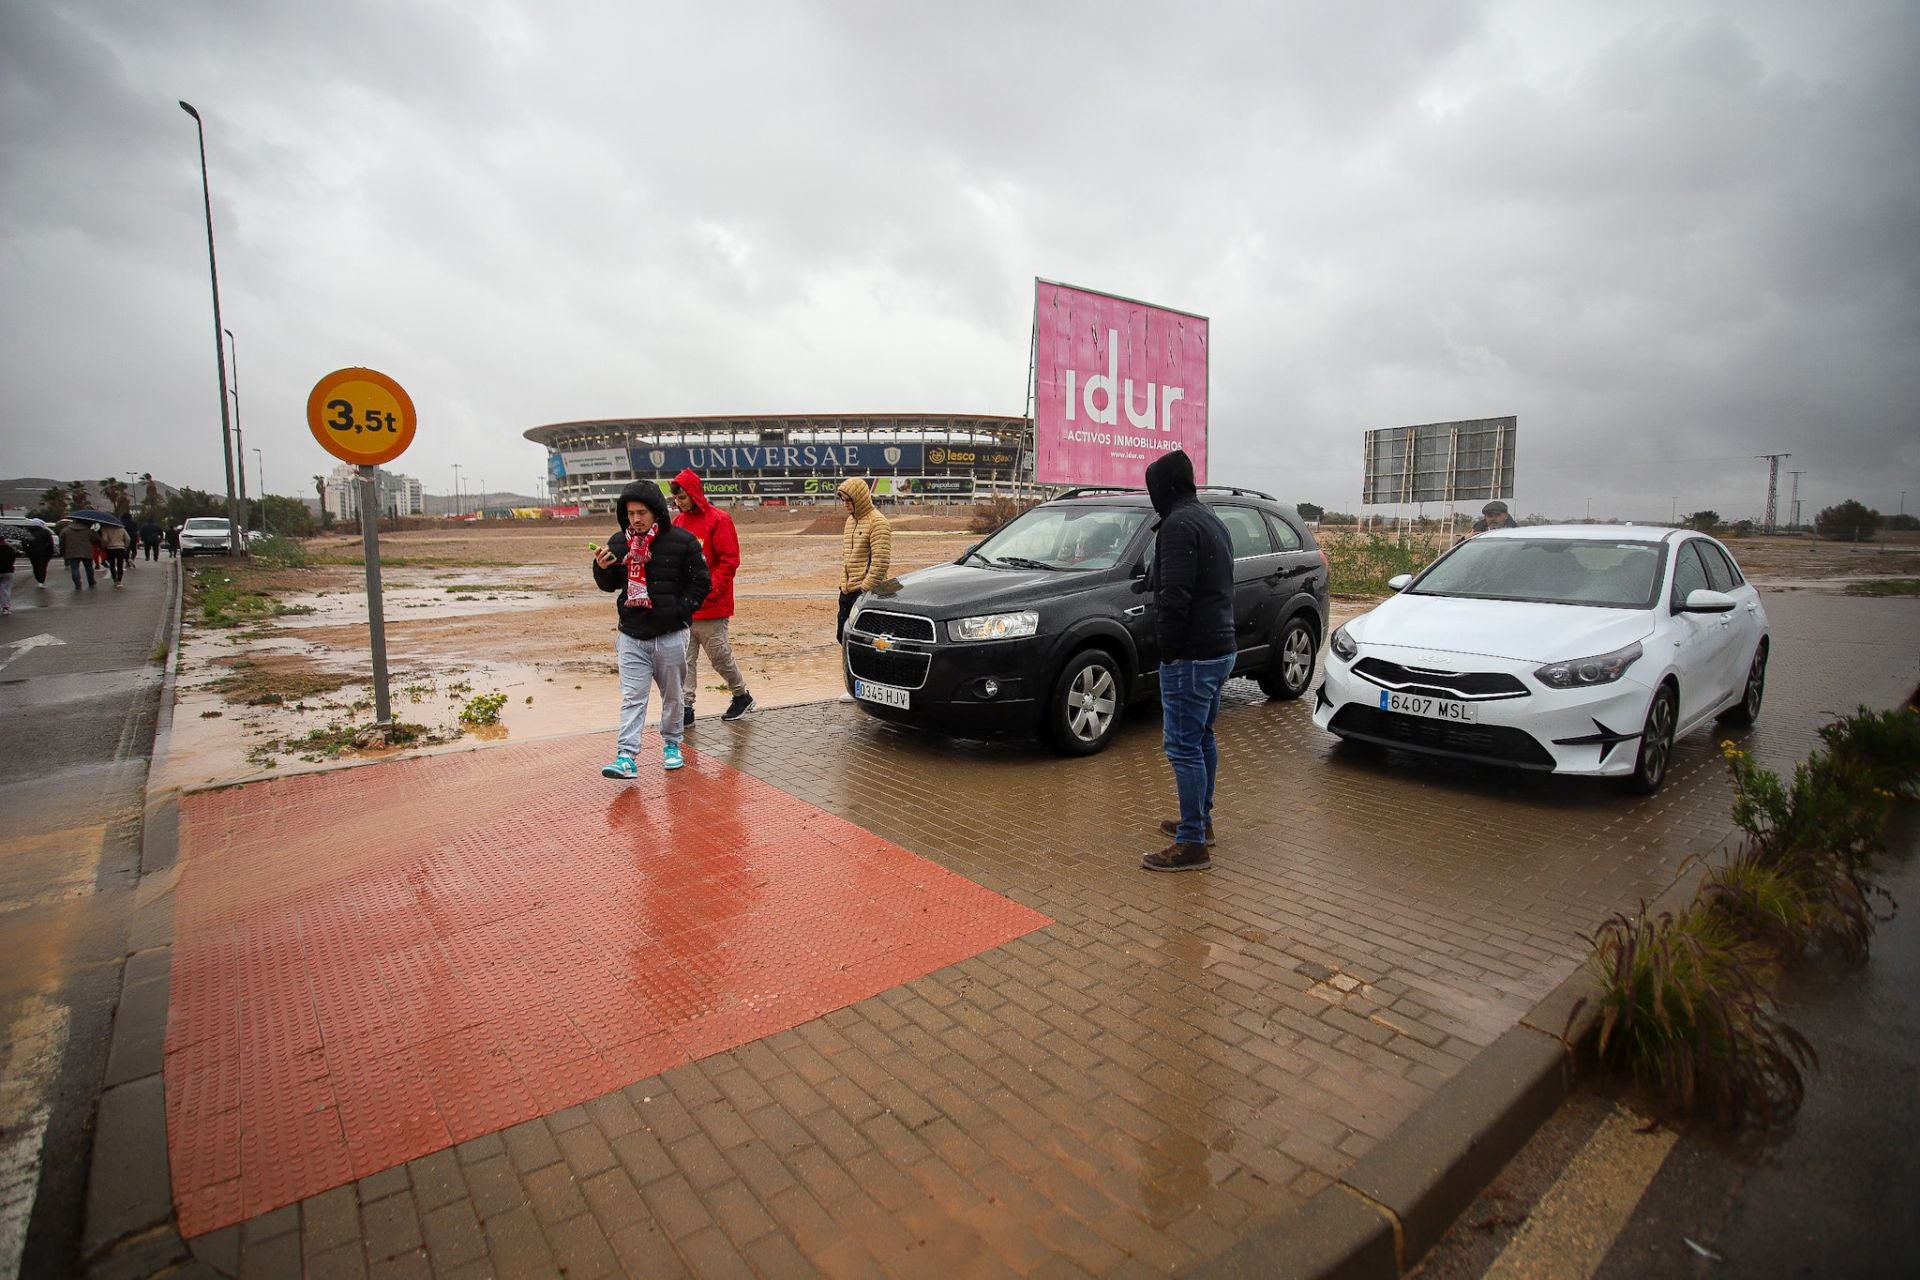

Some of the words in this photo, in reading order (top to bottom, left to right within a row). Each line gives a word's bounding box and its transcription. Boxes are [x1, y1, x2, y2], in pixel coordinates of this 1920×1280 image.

[326, 399, 397, 434] 3,5t
[1067, 430, 1111, 445] ACTIVOS
[1114, 435, 1183, 451] INMOBILIARIOS
[688, 446, 859, 468] UNIVERSAE
[1110, 450, 1145, 460] www.idur.es
[703, 482, 738, 492] fibranet
[860, 683, 883, 701] 0345
[886, 689, 906, 706] HJV
[1391, 695, 1432, 714] 6407
[1438, 701, 1471, 721] MSL
